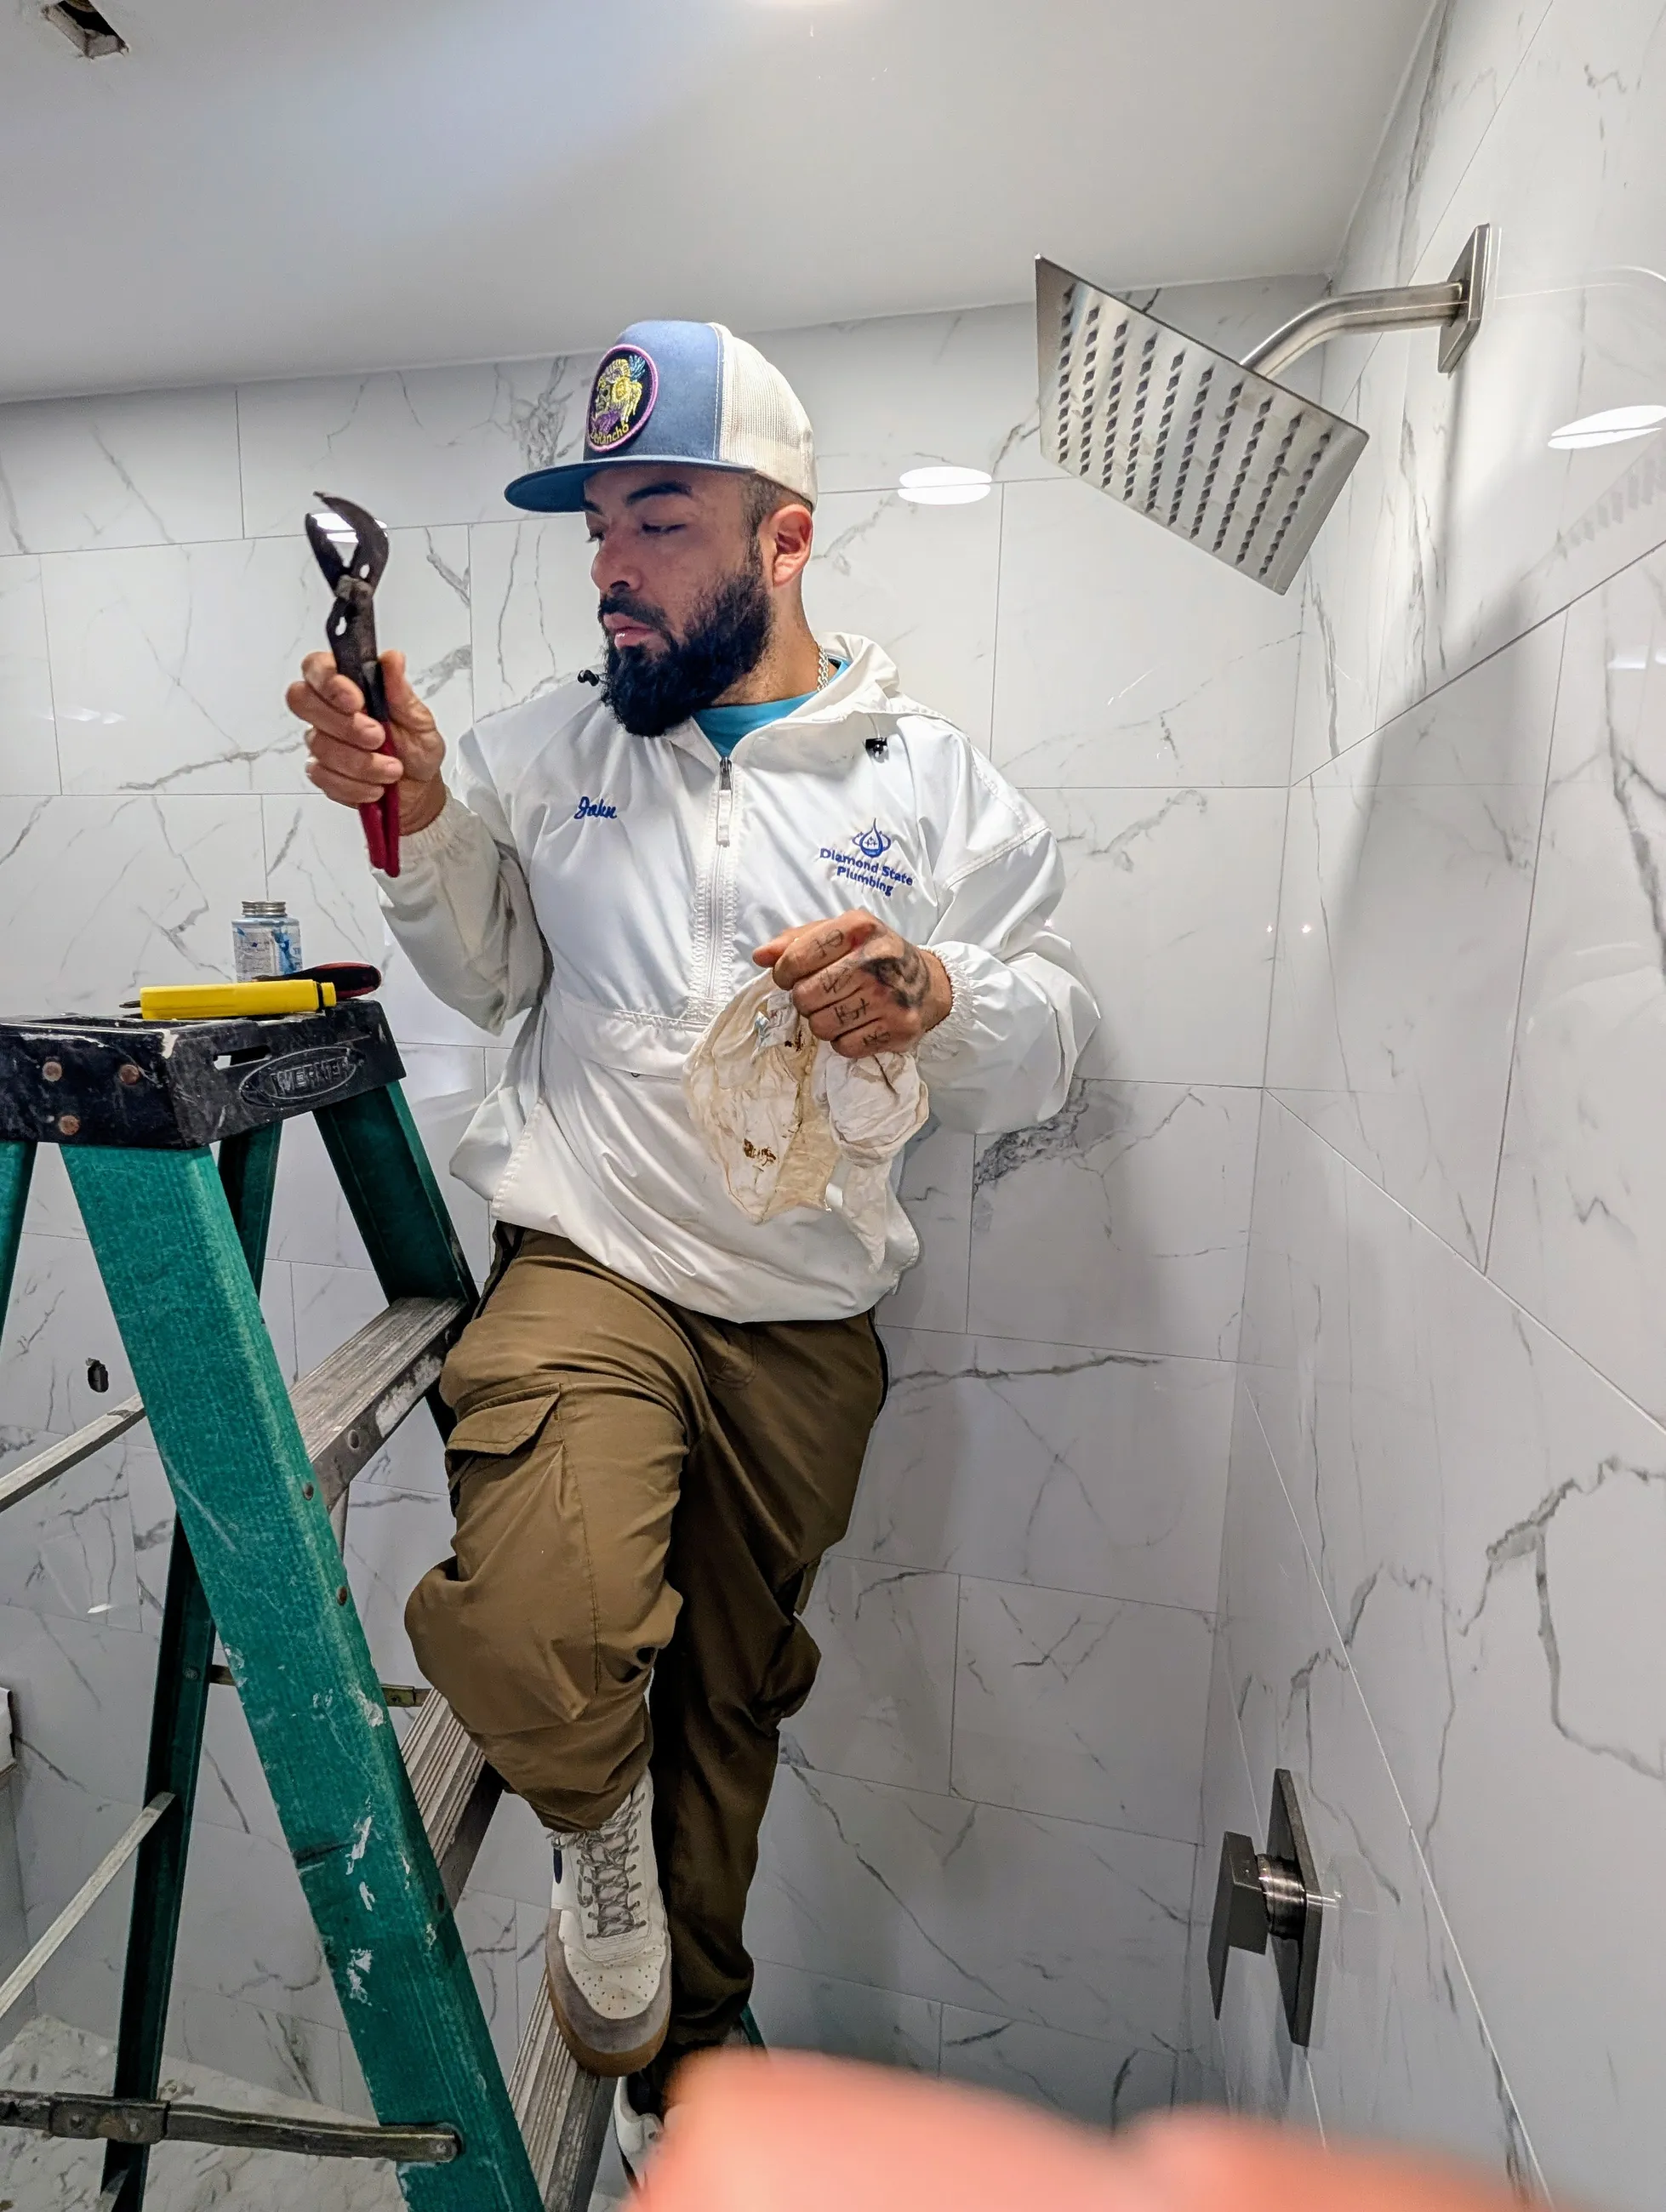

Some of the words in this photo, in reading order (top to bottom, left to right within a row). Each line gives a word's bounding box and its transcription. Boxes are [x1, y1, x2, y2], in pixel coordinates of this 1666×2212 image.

[819, 847, 879, 873] Diamond
[881, 866, 913, 886] State
[836, 866, 893, 897] Plumbing
[270, 1056, 349, 1096] WERNER
